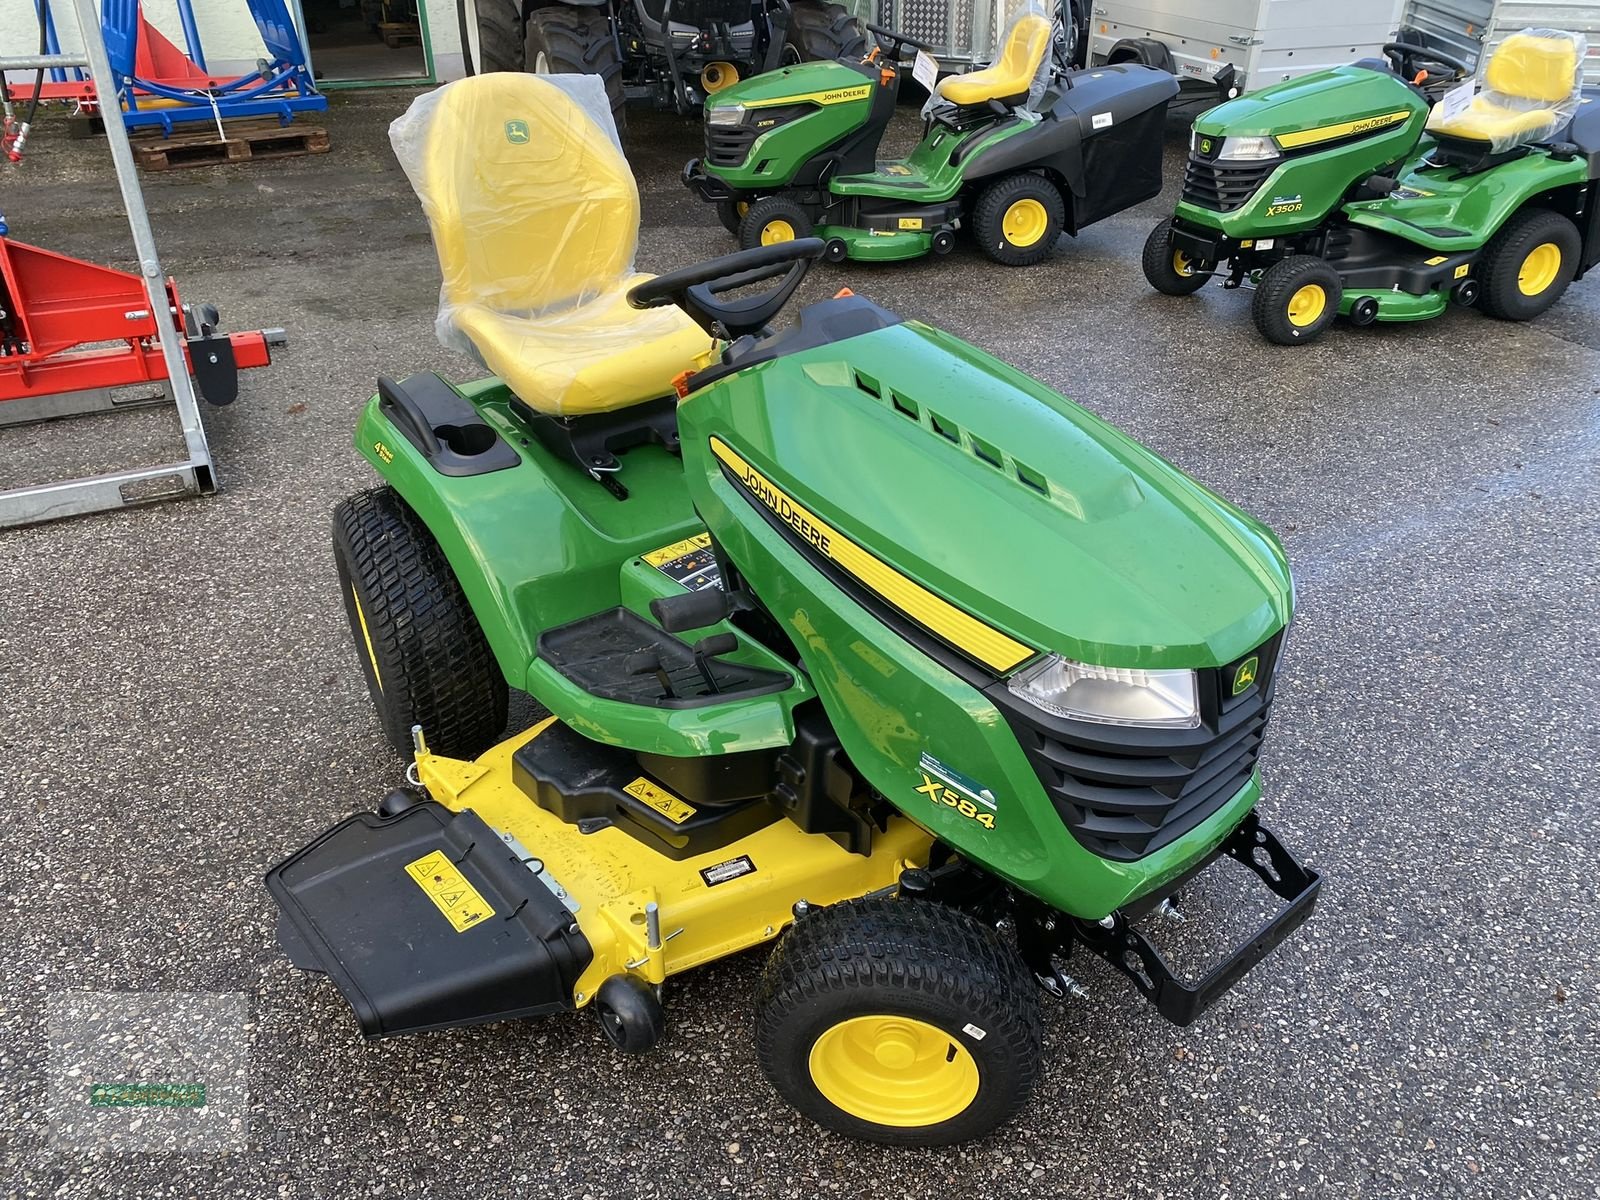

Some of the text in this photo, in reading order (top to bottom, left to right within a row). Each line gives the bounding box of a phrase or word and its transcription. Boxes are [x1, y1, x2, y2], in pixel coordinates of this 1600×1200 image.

[823, 89, 867, 101] JOHN DEERE
[1351, 115, 1393, 132] JOHN DEERE
[373, 441, 383, 453] 4
[741, 466, 832, 556] JOHN DEERE
[914, 772, 996, 829] X584
